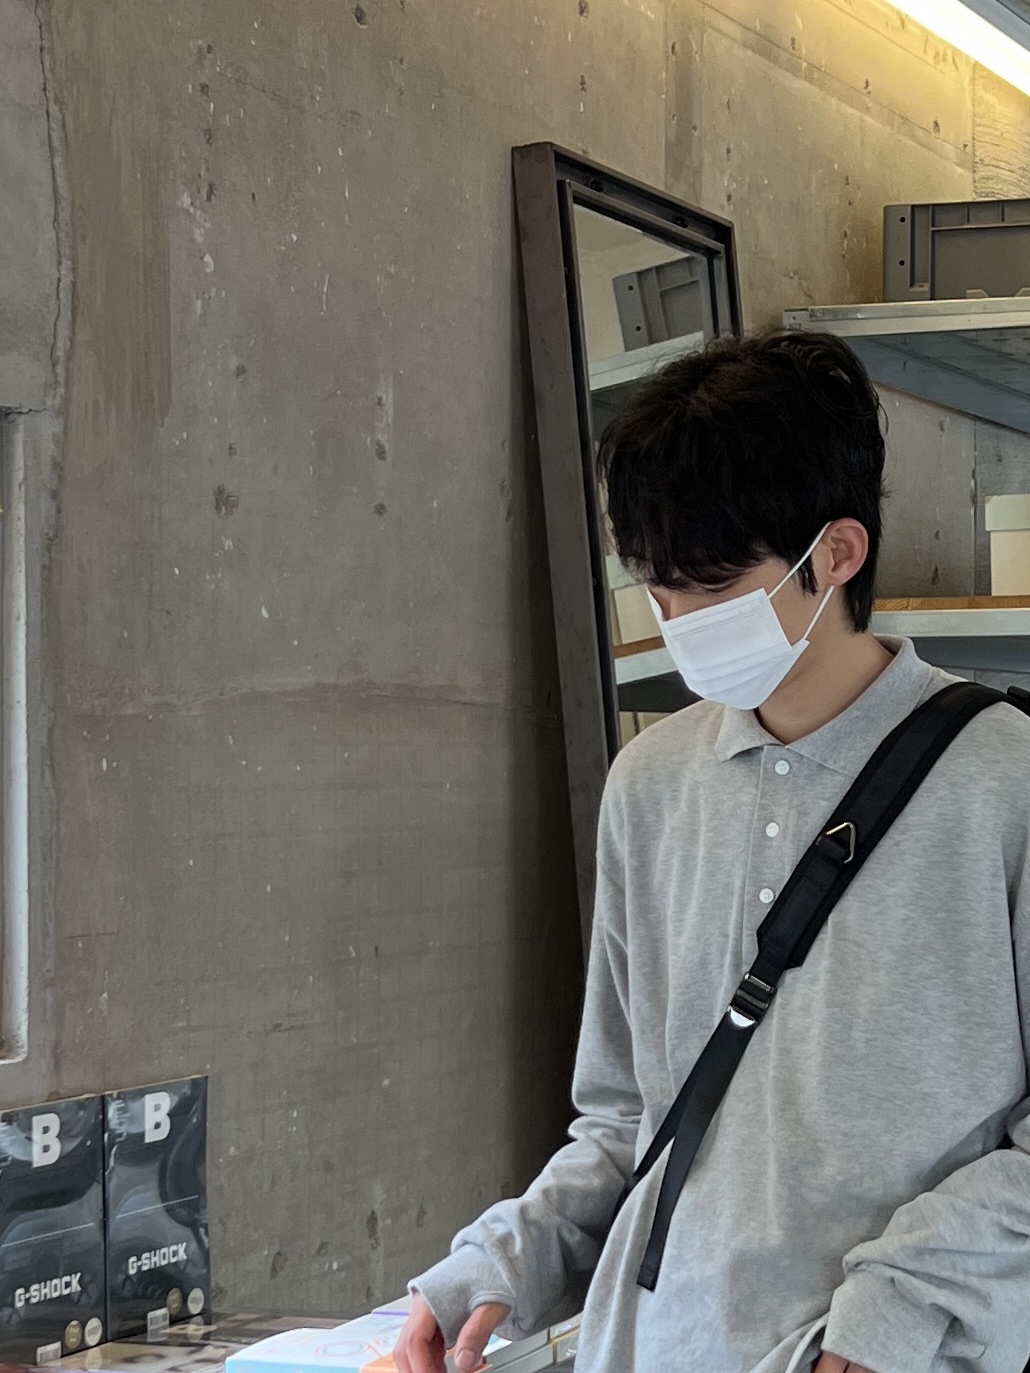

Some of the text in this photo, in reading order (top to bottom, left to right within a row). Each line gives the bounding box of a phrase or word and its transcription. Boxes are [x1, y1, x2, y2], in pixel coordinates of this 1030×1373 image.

[144, 1091, 171, 1143] B
[32, 1112, 61, 1168] B
[128, 1242, 187, 1275] G-SHOCK
[14, 1272, 82, 1308] G-SHOCK
